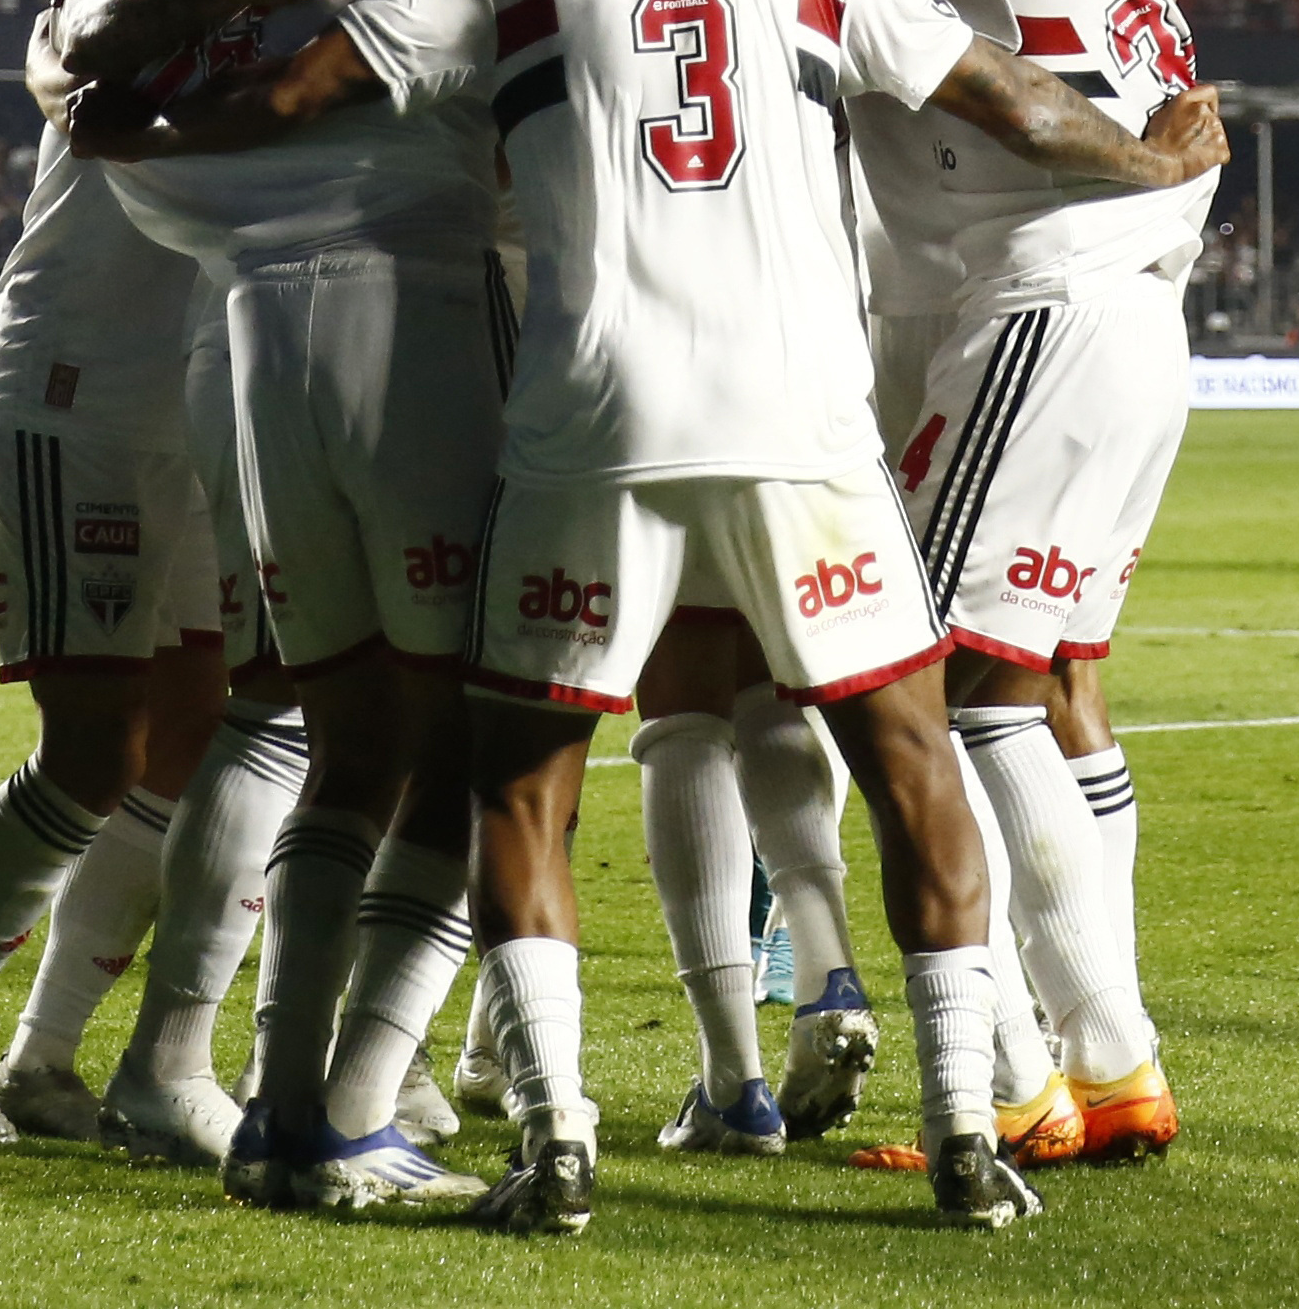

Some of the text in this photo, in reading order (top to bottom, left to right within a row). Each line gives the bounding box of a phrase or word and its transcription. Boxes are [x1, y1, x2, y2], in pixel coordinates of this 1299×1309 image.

[403, 534, 482, 590] ab
[794, 551, 883, 619] abc
[518, 567, 612, 627] abc
[806, 598, 890, 638] da construção
[1000, 590, 1019, 605] da
